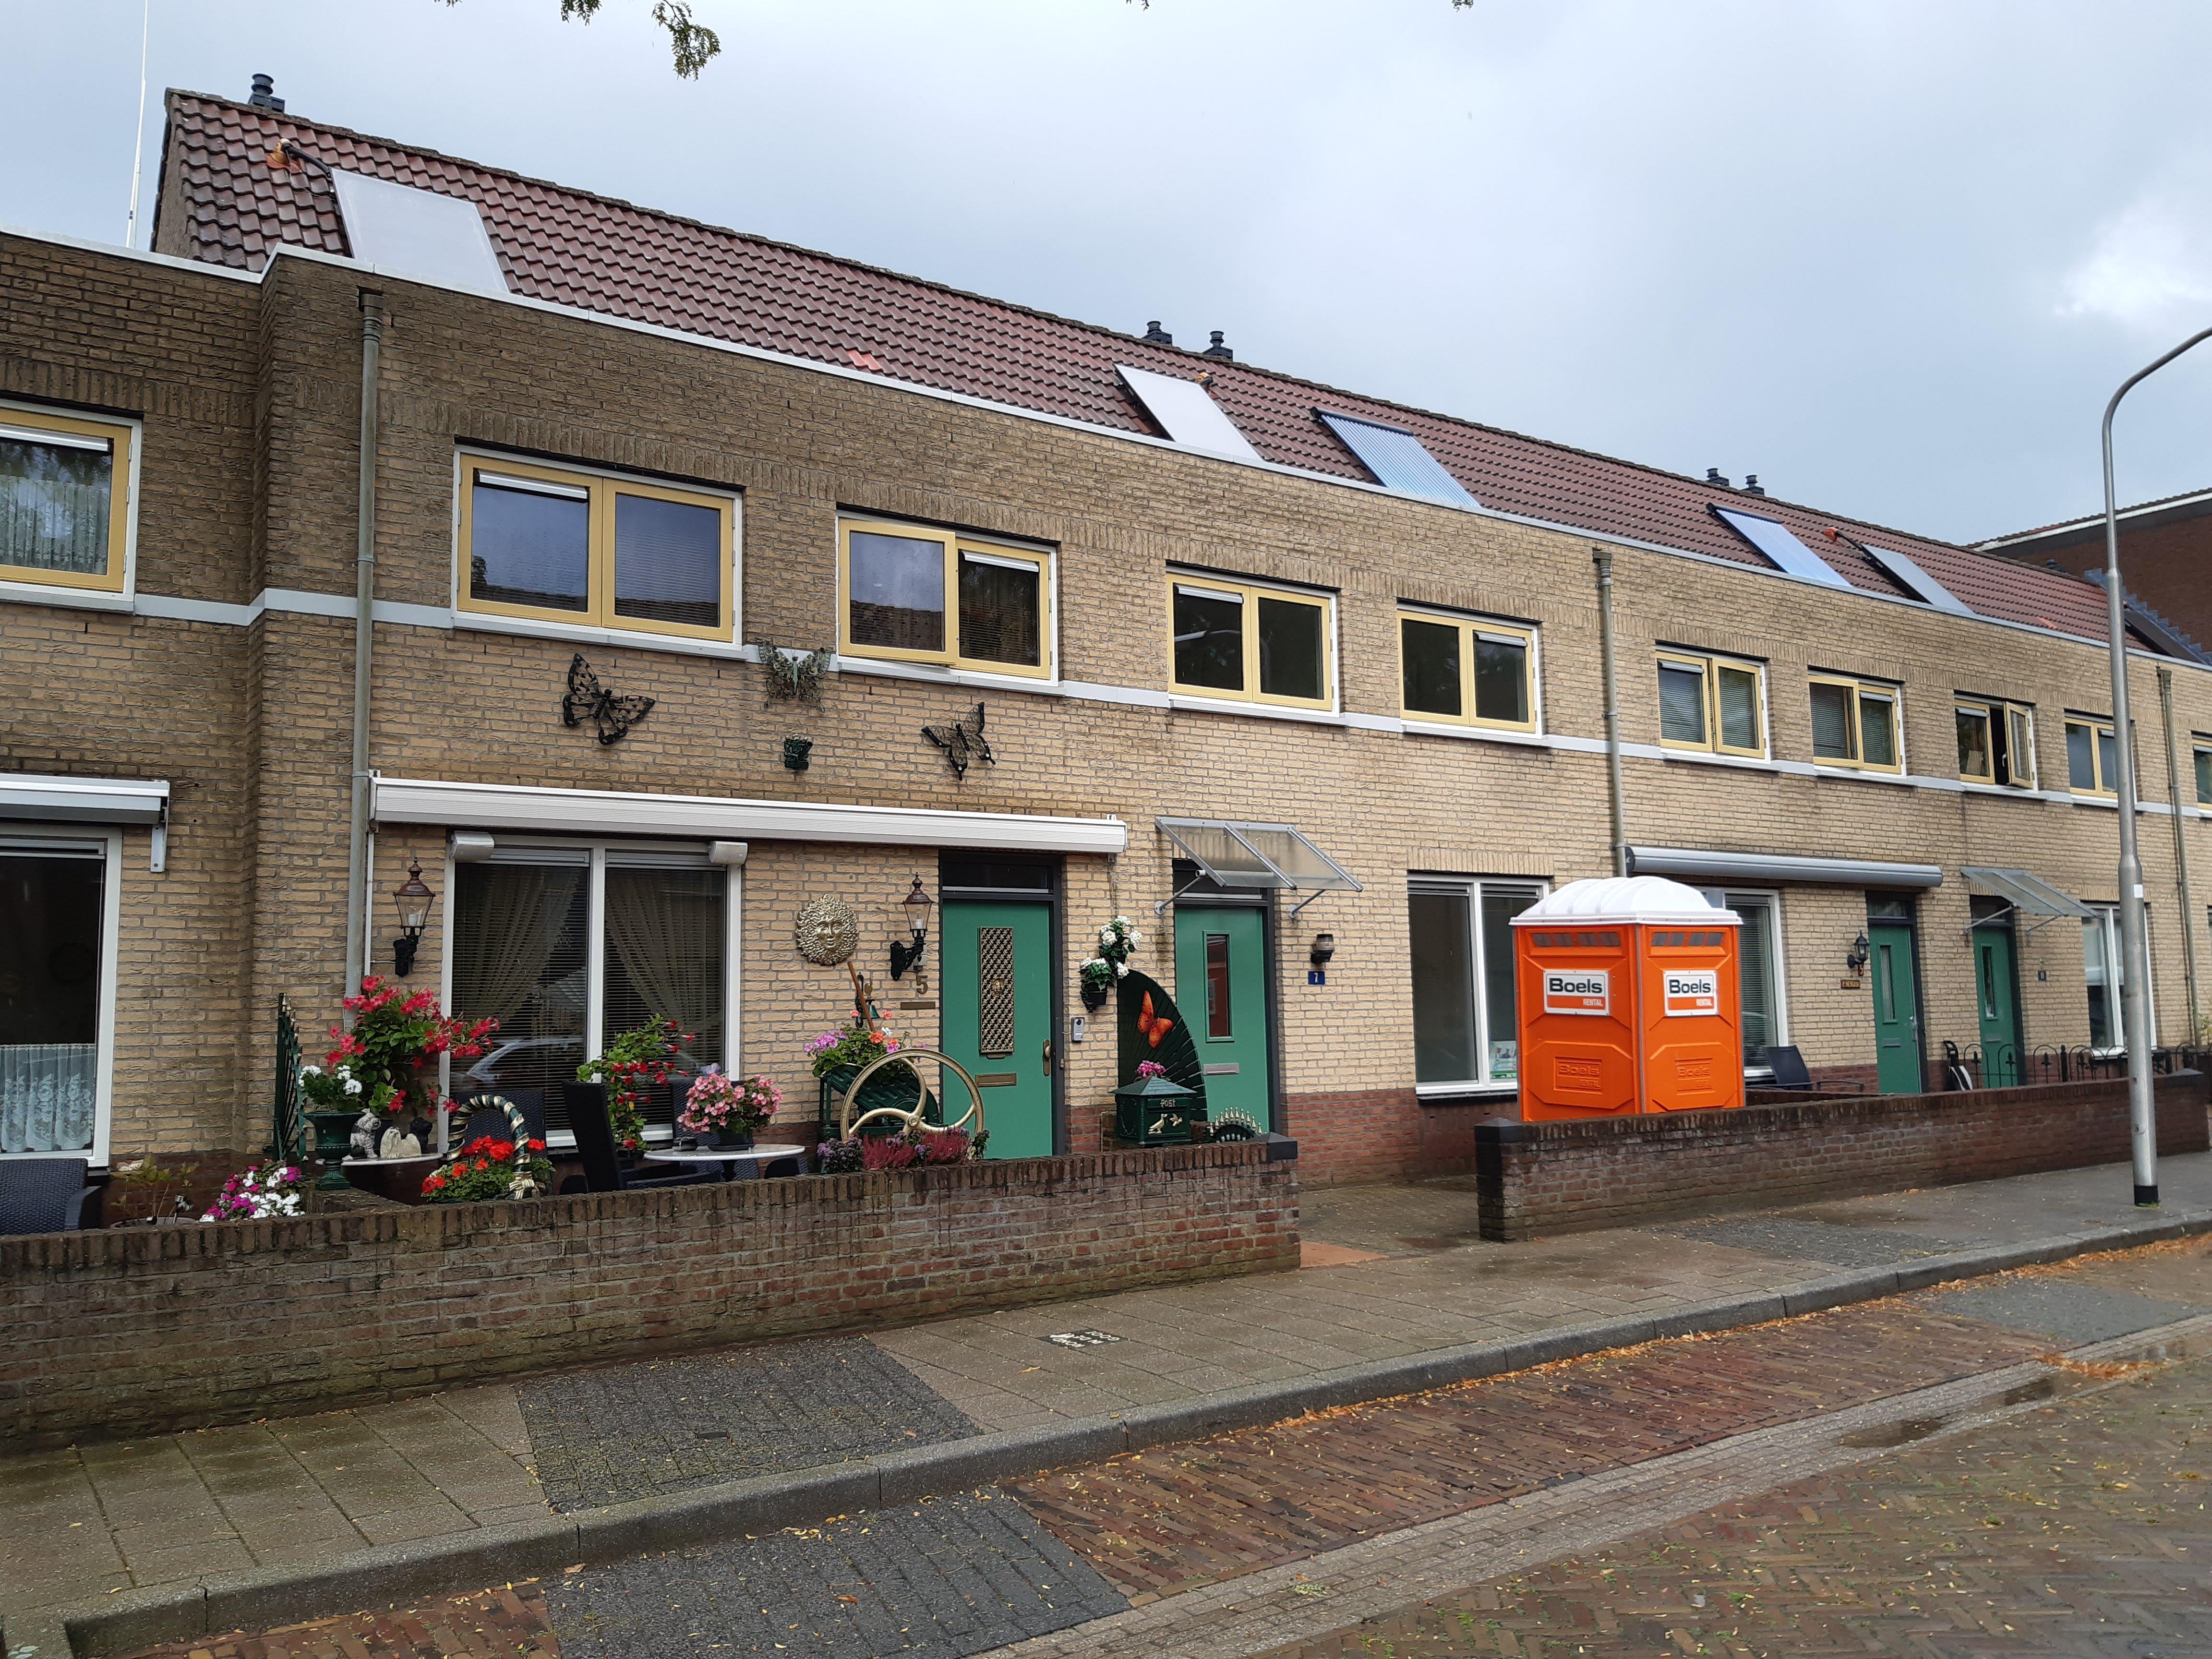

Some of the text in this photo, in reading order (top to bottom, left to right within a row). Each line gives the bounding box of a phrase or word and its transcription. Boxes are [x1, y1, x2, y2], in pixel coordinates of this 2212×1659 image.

[916, 975, 928, 994] 5
[1314, 973, 1318, 983] 7
[1549, 978, 1602, 993] Boels
[1669, 979, 1711, 994] Boels
[1583, 998, 1604, 1007] RENTAL
[1559, 1064, 1599, 1076] Boels
